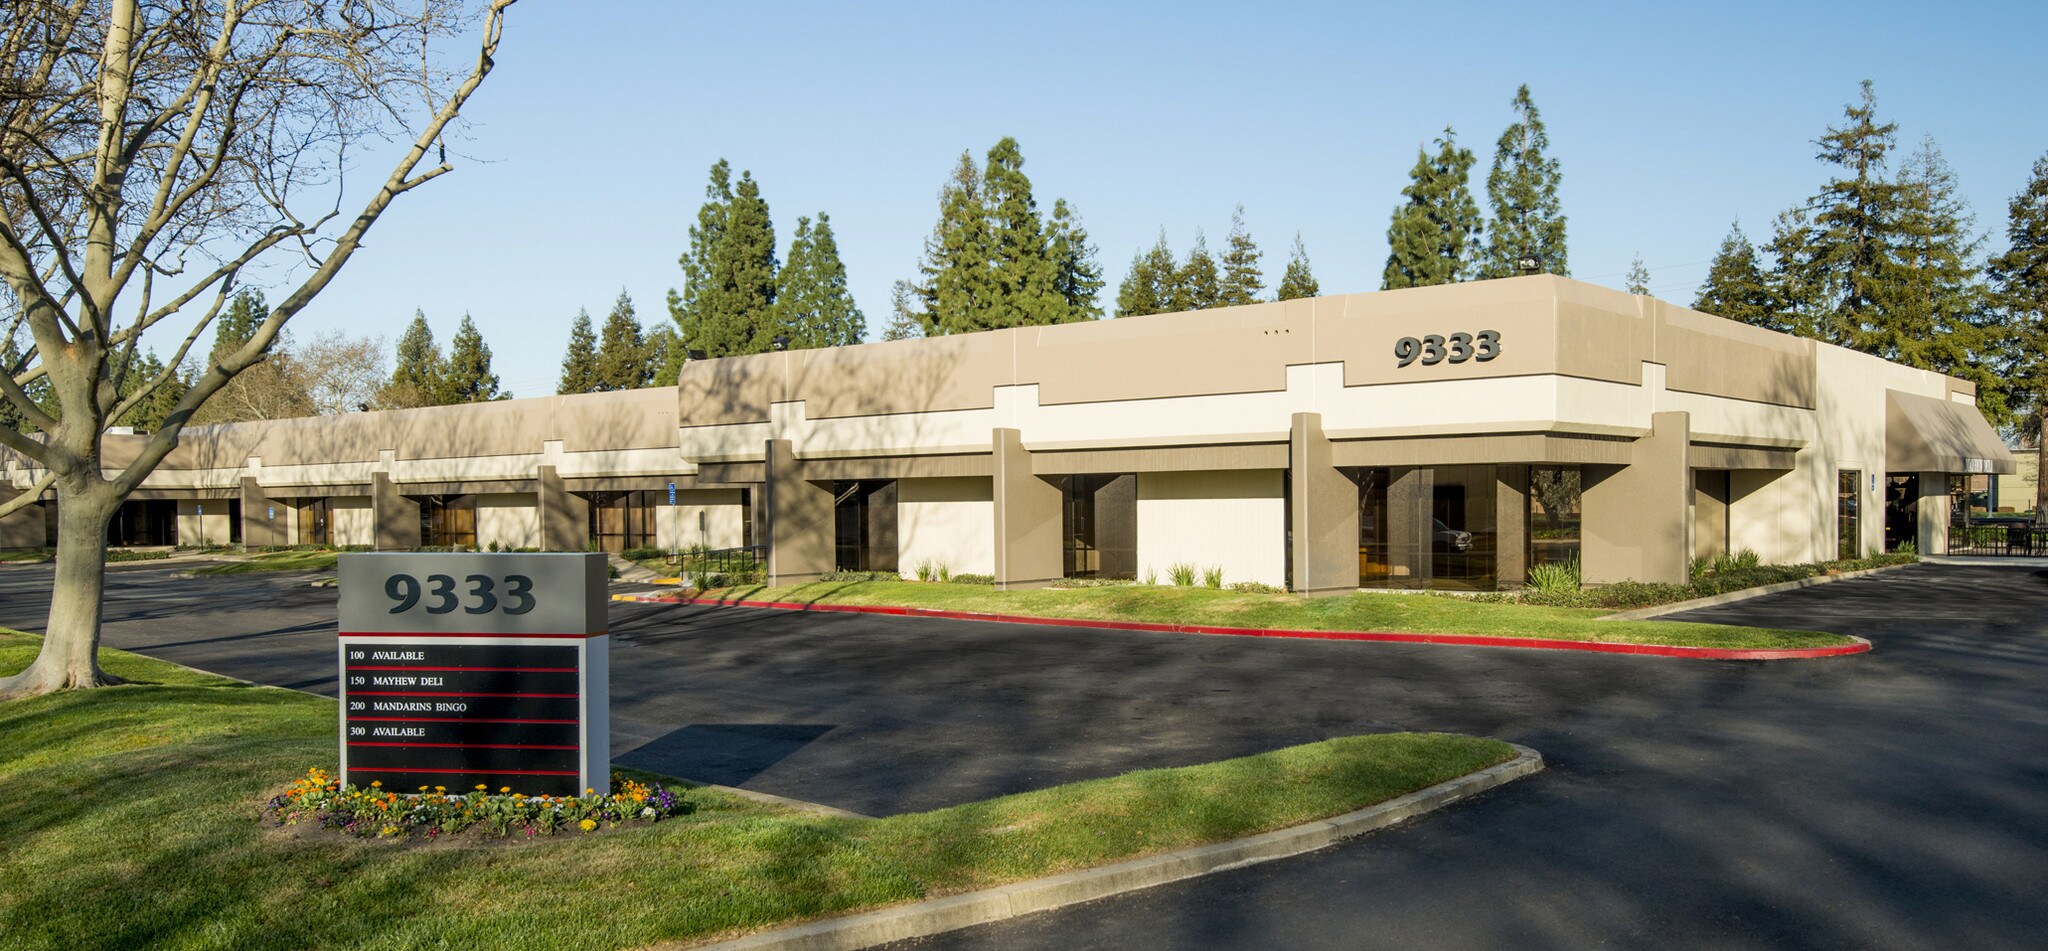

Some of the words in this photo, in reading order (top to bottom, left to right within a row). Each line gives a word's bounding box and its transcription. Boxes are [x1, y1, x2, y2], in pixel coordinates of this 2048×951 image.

[1394, 329, 1502, 369] 9333
[384, 573, 536, 615] 9333
[349, 650, 365, 661] 100
[371, 650, 425, 661] AVAILABLE
[349, 675, 366, 686] 150
[373, 676, 417, 686] MAYHEW
[420, 676, 444, 687] DELI
[349, 701, 366, 711] 200
[373, 701, 432, 712] MANDARINS
[435, 702, 467, 712] BINGO
[350, 726, 366, 736] 300
[372, 726, 426, 737] AVAILABLE
